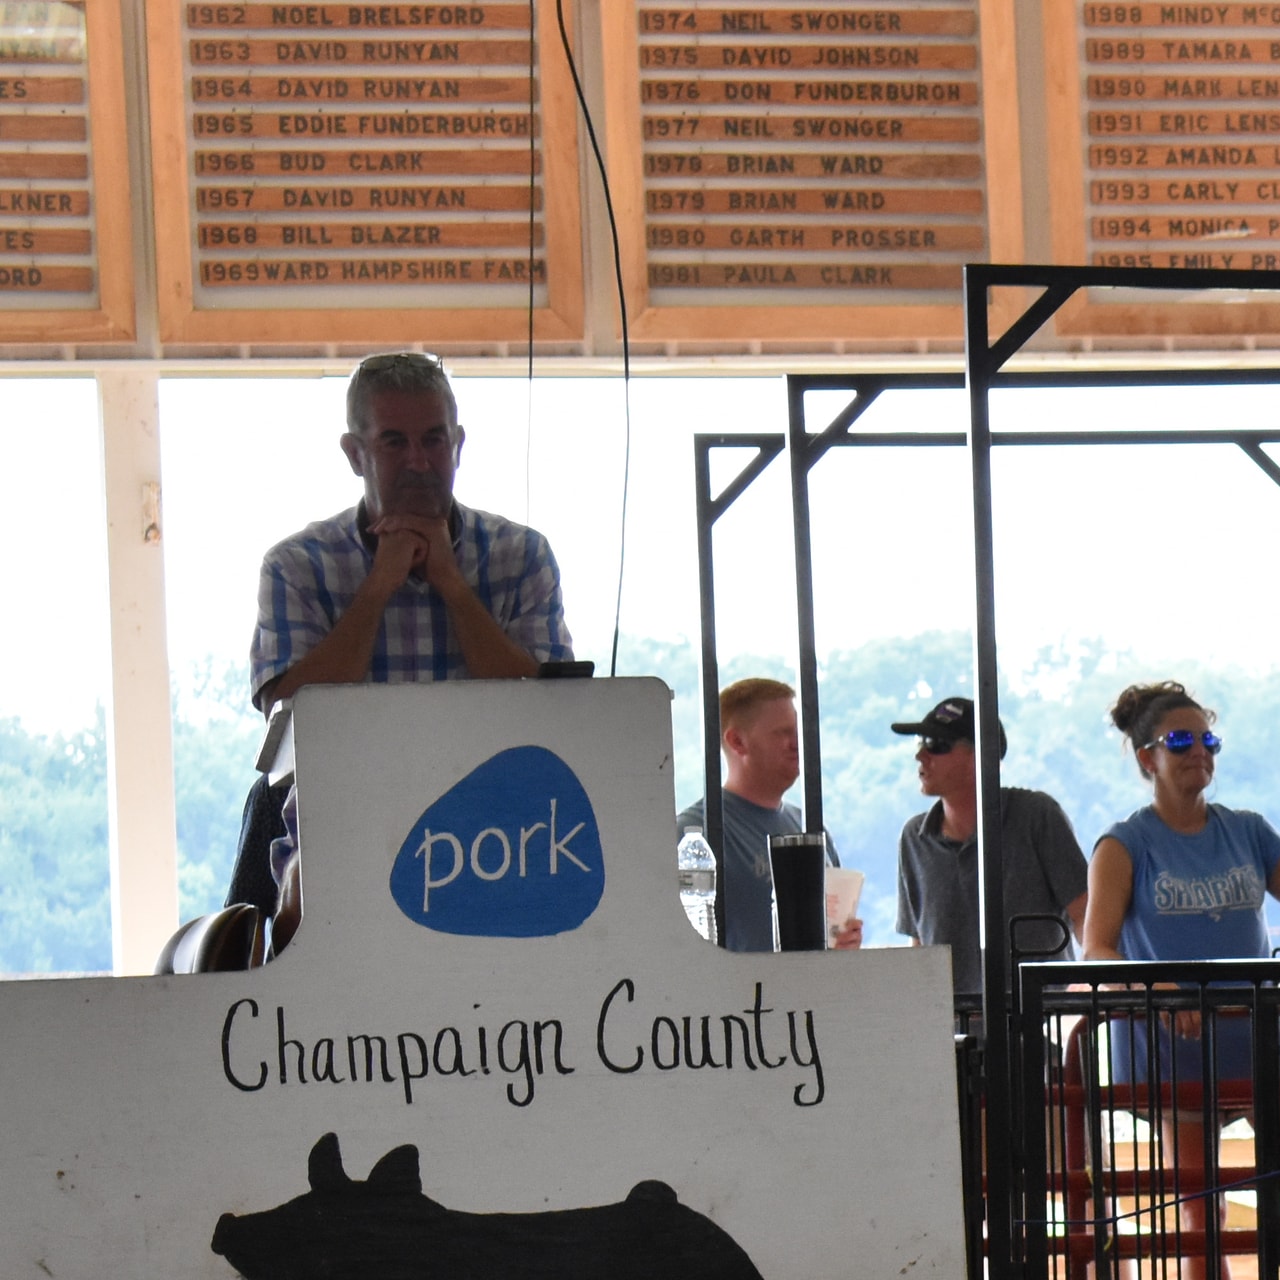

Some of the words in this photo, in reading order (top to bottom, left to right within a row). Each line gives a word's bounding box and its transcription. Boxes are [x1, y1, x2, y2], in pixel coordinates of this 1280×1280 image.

[190, 7, 245, 24] 1962
[273, 7, 332, 24] NOEL
[349, 7, 484, 24] BRELSFORD
[643, 14, 697, 31] 1974
[722, 14, 771, 31] NEIL
[791, 14, 901, 31] SWONGER
[1091, 8, 1142, 23] 1988
[1161, 8, 1228, 23] MINDY
[194, 44, 250, 60] 1963
[277, 44, 346, 60] DAVID
[363, 44, 459, 60] RUNYAN
[644, 48, 698, 65] 1975
[722, 48, 792, 65] DAVID
[813, 48, 918, 65] JOHNSON
[1092, 42, 1145, 59] 1989
[1163, 42, 1251, 59] TAMARA
[195, 80, 252, 97] 1964
[278, 80, 348, 97] DAVID
[364, 80, 459, 97] RUNYAN
[646, 83, 700, 100] 1976
[725, 83, 771, 100] DON
[1095, 80, 1145, 96] 1990
[1164, 80, 1221, 96] MARK
[197, 116, 253, 134] 1965
[279, 116, 346, 134] EDDIE
[647, 119, 699, 136] 1977
[725, 119, 773, 136] NEIL
[793, 119, 902, 136] SWONGER
[1096, 114, 1142, 131] 1991
[1160, 114, 1208, 131] ERIC
[198, 153, 254, 171] 1966
[280, 153, 325, 171] BUD
[349, 153, 423, 171] CLARK
[727, 156, 794, 173] BRIAN
[821, 156, 883, 173] WARD
[1096, 149, 1148, 165] 1992
[1166, 149, 1257, 165] AMANDA
[199, 190, 254, 207] 1967
[284, 190, 353, 207] DAVID
[370, 190, 466, 207] RUNYAN
[1099, 183, 1150, 200] 1993
[1168, 183, 1238, 200] CARLY
[729, 193, 797, 210] BRIAN
[823, 193, 884, 210] WARD
[202, 226, 257, 244] 1968
[282, 226, 332, 244] BILL
[352, 226, 441, 244] BLAZER
[1099, 219, 1151, 236] 1994
[731, 229, 804, 246] GARTH
[832, 229, 935, 246] PROSSER
[204, 262, 259, 280] 1969
[264, 262, 328, 280] WARD
[342, 261, 471, 279] HAMPSHIRE
[485, 260, 545, 278] FARM
[1101, 254, 1153, 270] 1995
[1169, 254, 1232, 270] EMILY
[821, 267, 892, 285] CLARK
[415, 798, 591, 912] pork
[222, 998, 576, 1107] Champaign
[599, 979, 826, 1106] County
